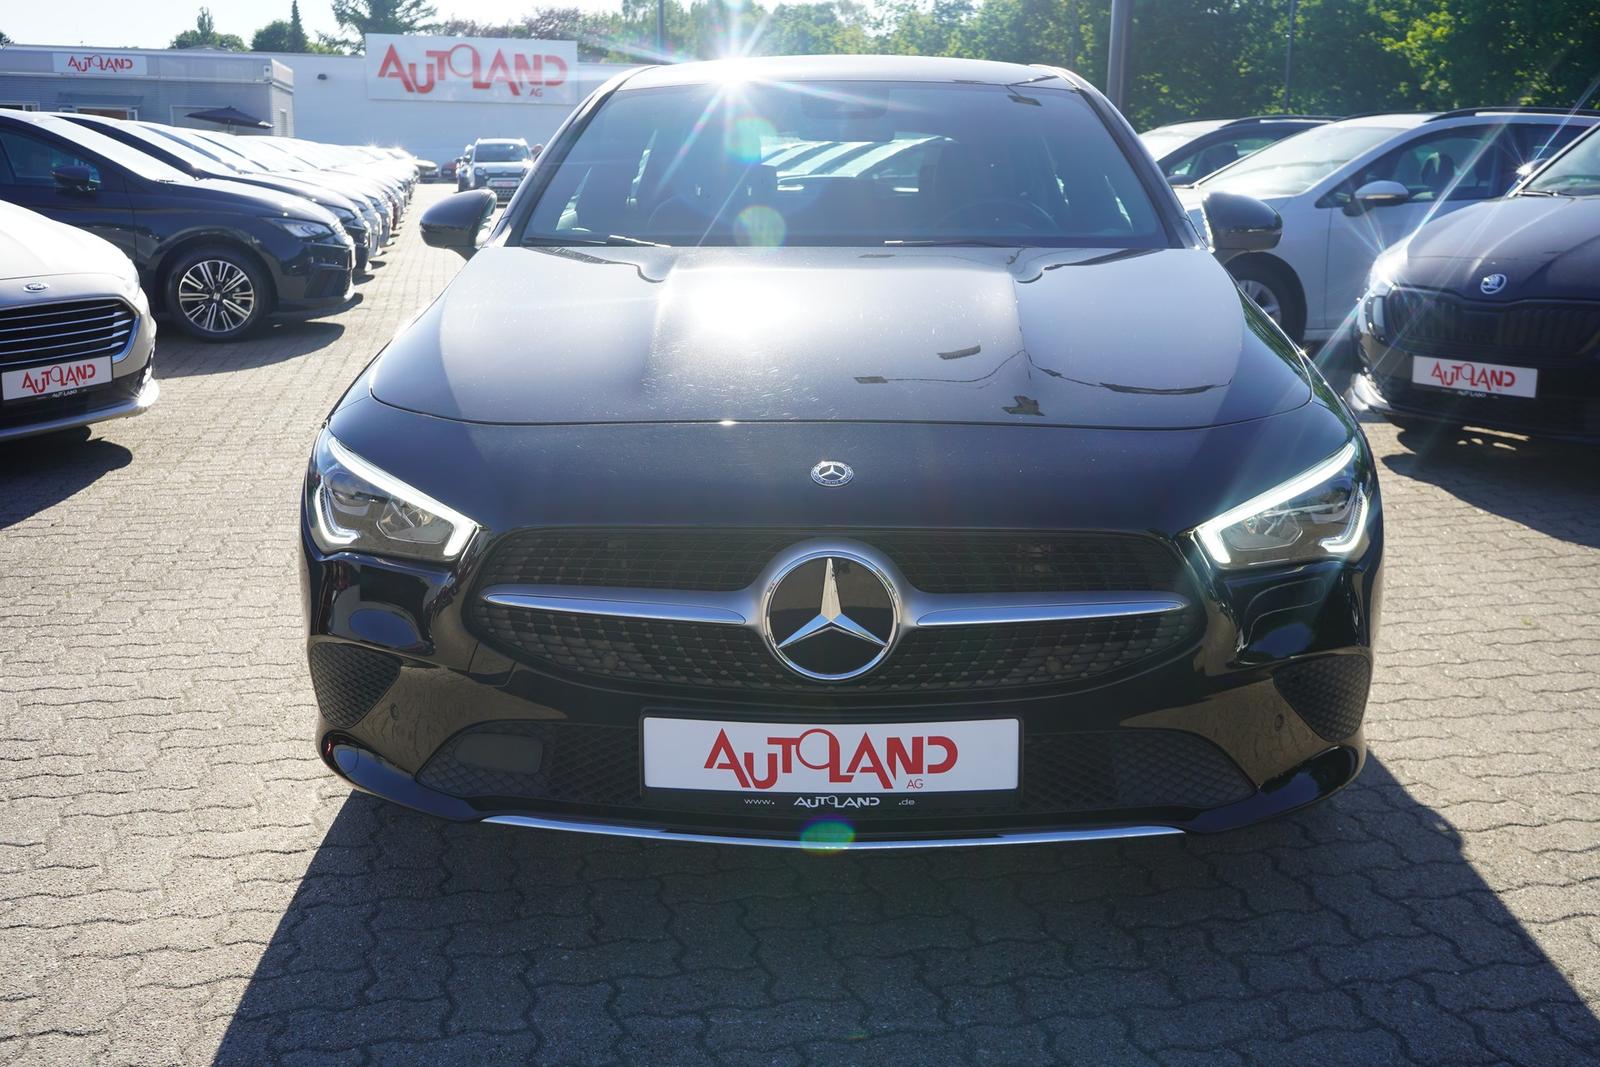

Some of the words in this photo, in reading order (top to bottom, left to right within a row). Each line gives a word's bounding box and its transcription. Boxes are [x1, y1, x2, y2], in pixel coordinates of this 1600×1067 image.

[68, 55, 133, 72] AUTOLAND
[378, 43, 568, 96] AUTOLAND
[530, 88, 543, 97] AG
[22, 364, 96, 393] AUTOLAND
[1431, 361, 1516, 391] AUTOLAND
[703, 728, 958, 789] AUTOLAND
[907, 779, 924, 789] AG
[793, 795, 880, 808] AUTOLAND
[898, 798, 915, 806] .de
